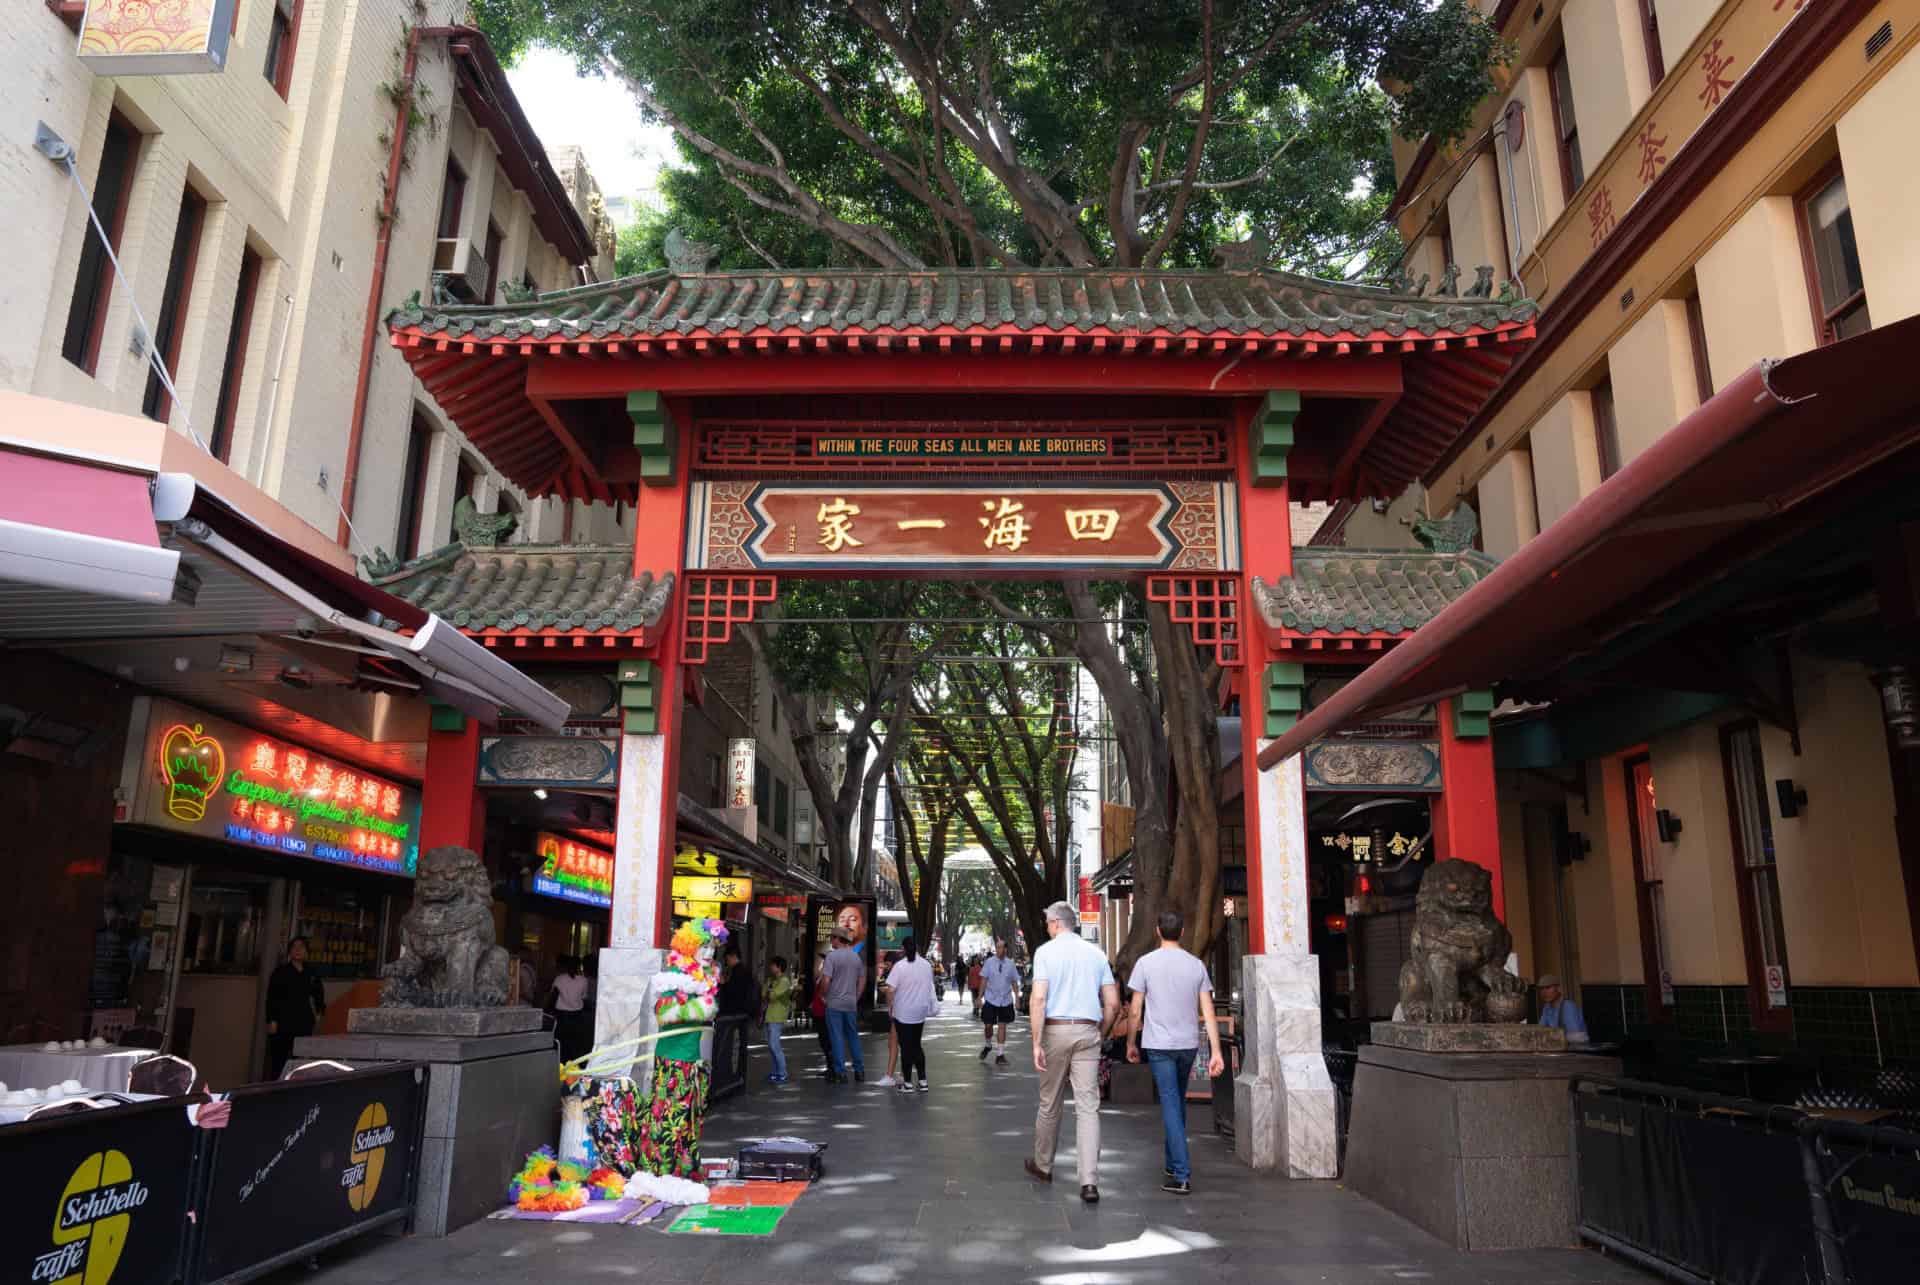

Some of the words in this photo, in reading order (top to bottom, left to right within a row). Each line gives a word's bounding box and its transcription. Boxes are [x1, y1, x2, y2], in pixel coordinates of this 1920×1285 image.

[818, 439, 856, 453] WITHIN
[860, 439, 883, 453] THE
[887, 439, 919, 453] FOUR
[924, 439, 955, 453] SEAS
[960, 439, 984, 453] ALL
[987, 439, 1013, 453] MEN
[1018, 439, 1041, 453] ARE
[1046, 439, 1107, 453] BROTHERS
[281, 836, 307, 852] LUNCH
[355, 1125, 395, 1152] Schibello
[61, 1181, 149, 1227] Schibello
